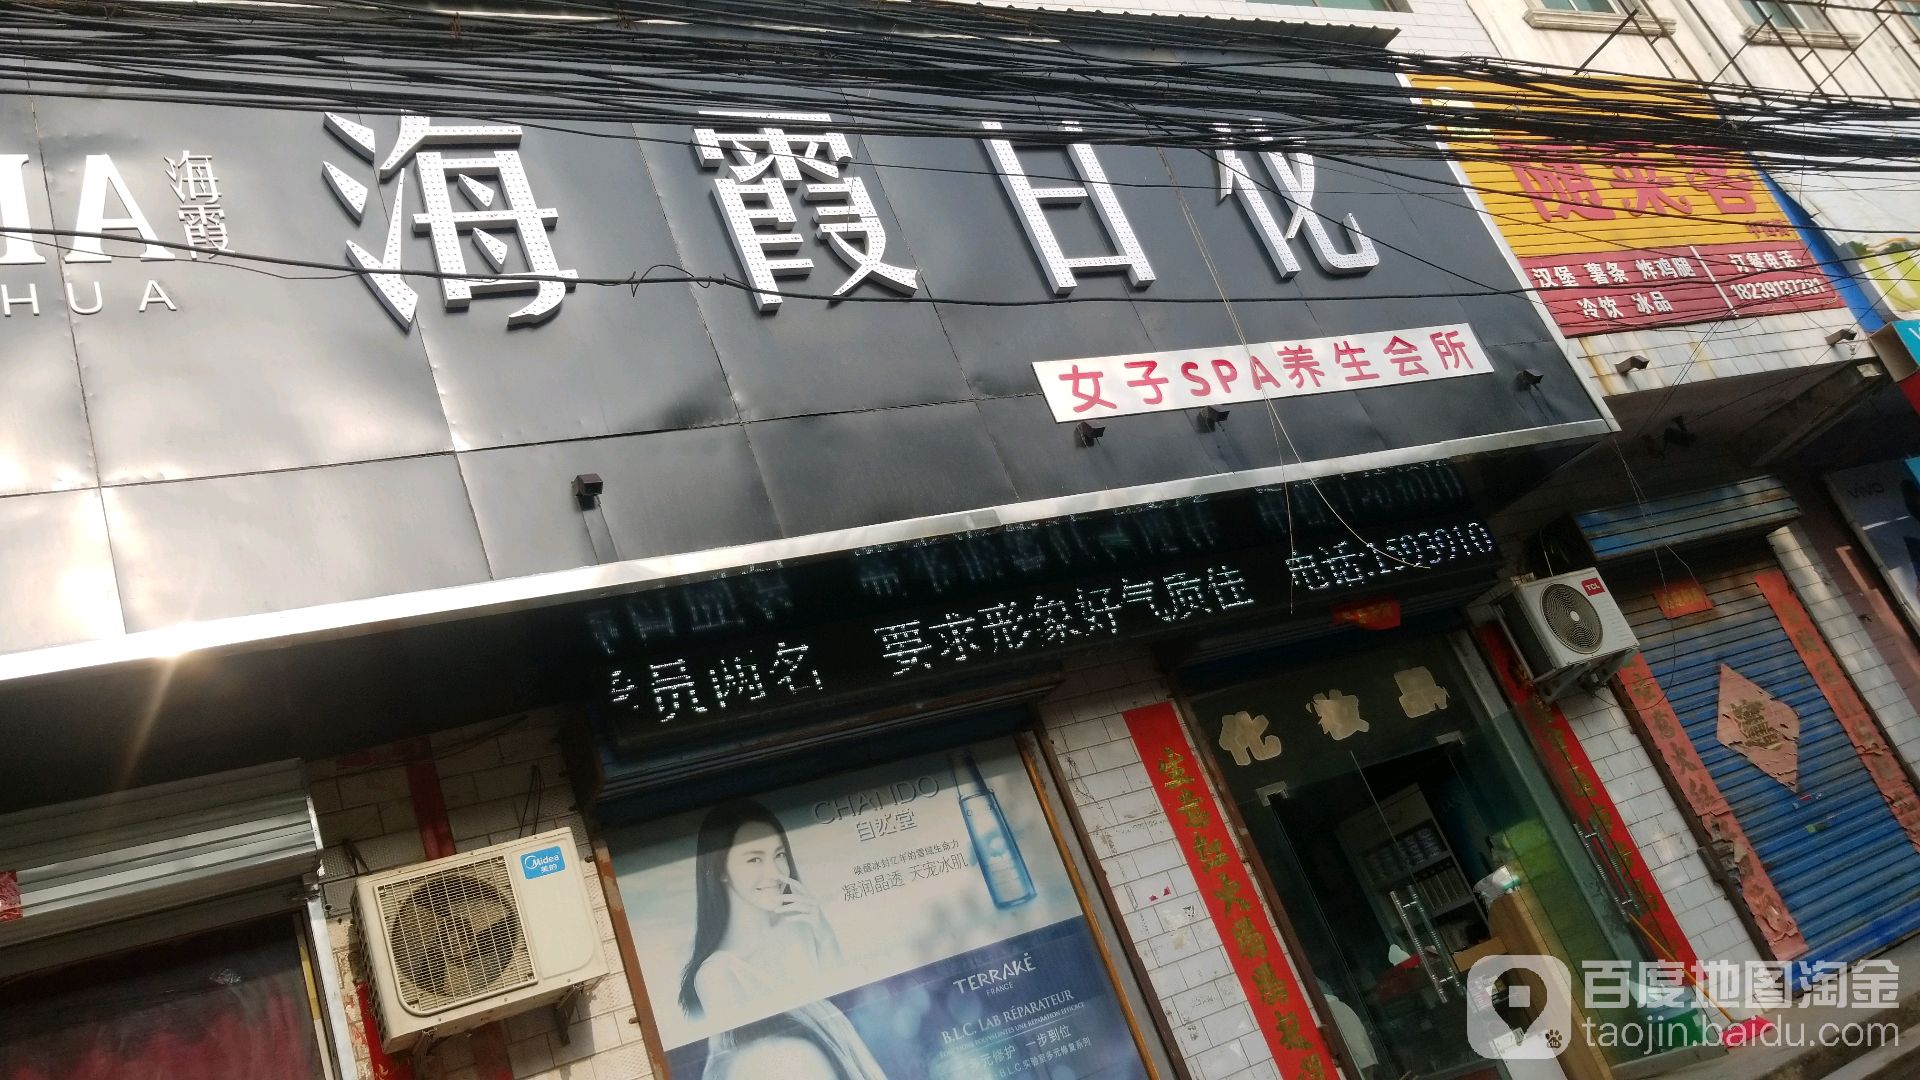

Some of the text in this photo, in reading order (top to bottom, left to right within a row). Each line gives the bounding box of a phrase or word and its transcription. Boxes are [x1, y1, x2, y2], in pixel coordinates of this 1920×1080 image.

[162, 150, 236, 261] 海霞
[323, 107, 1380, 334] 海霞日化
[1532, 257, 1697, 288] 汉堡 薯条 炸鸡腿
[1576, 290, 1674, 319] 冷饮 冰品
[1058, 330, 1475, 413] 女子SPA养生会所
[1585, 582, 1601, 591] TCL
[813, 774, 941, 826] CHANDO
[524, 854, 561, 870] Midea
[985, 981, 1014, 997] FRANCE
[1024, 1024, 1073, 1048] 一步到位
